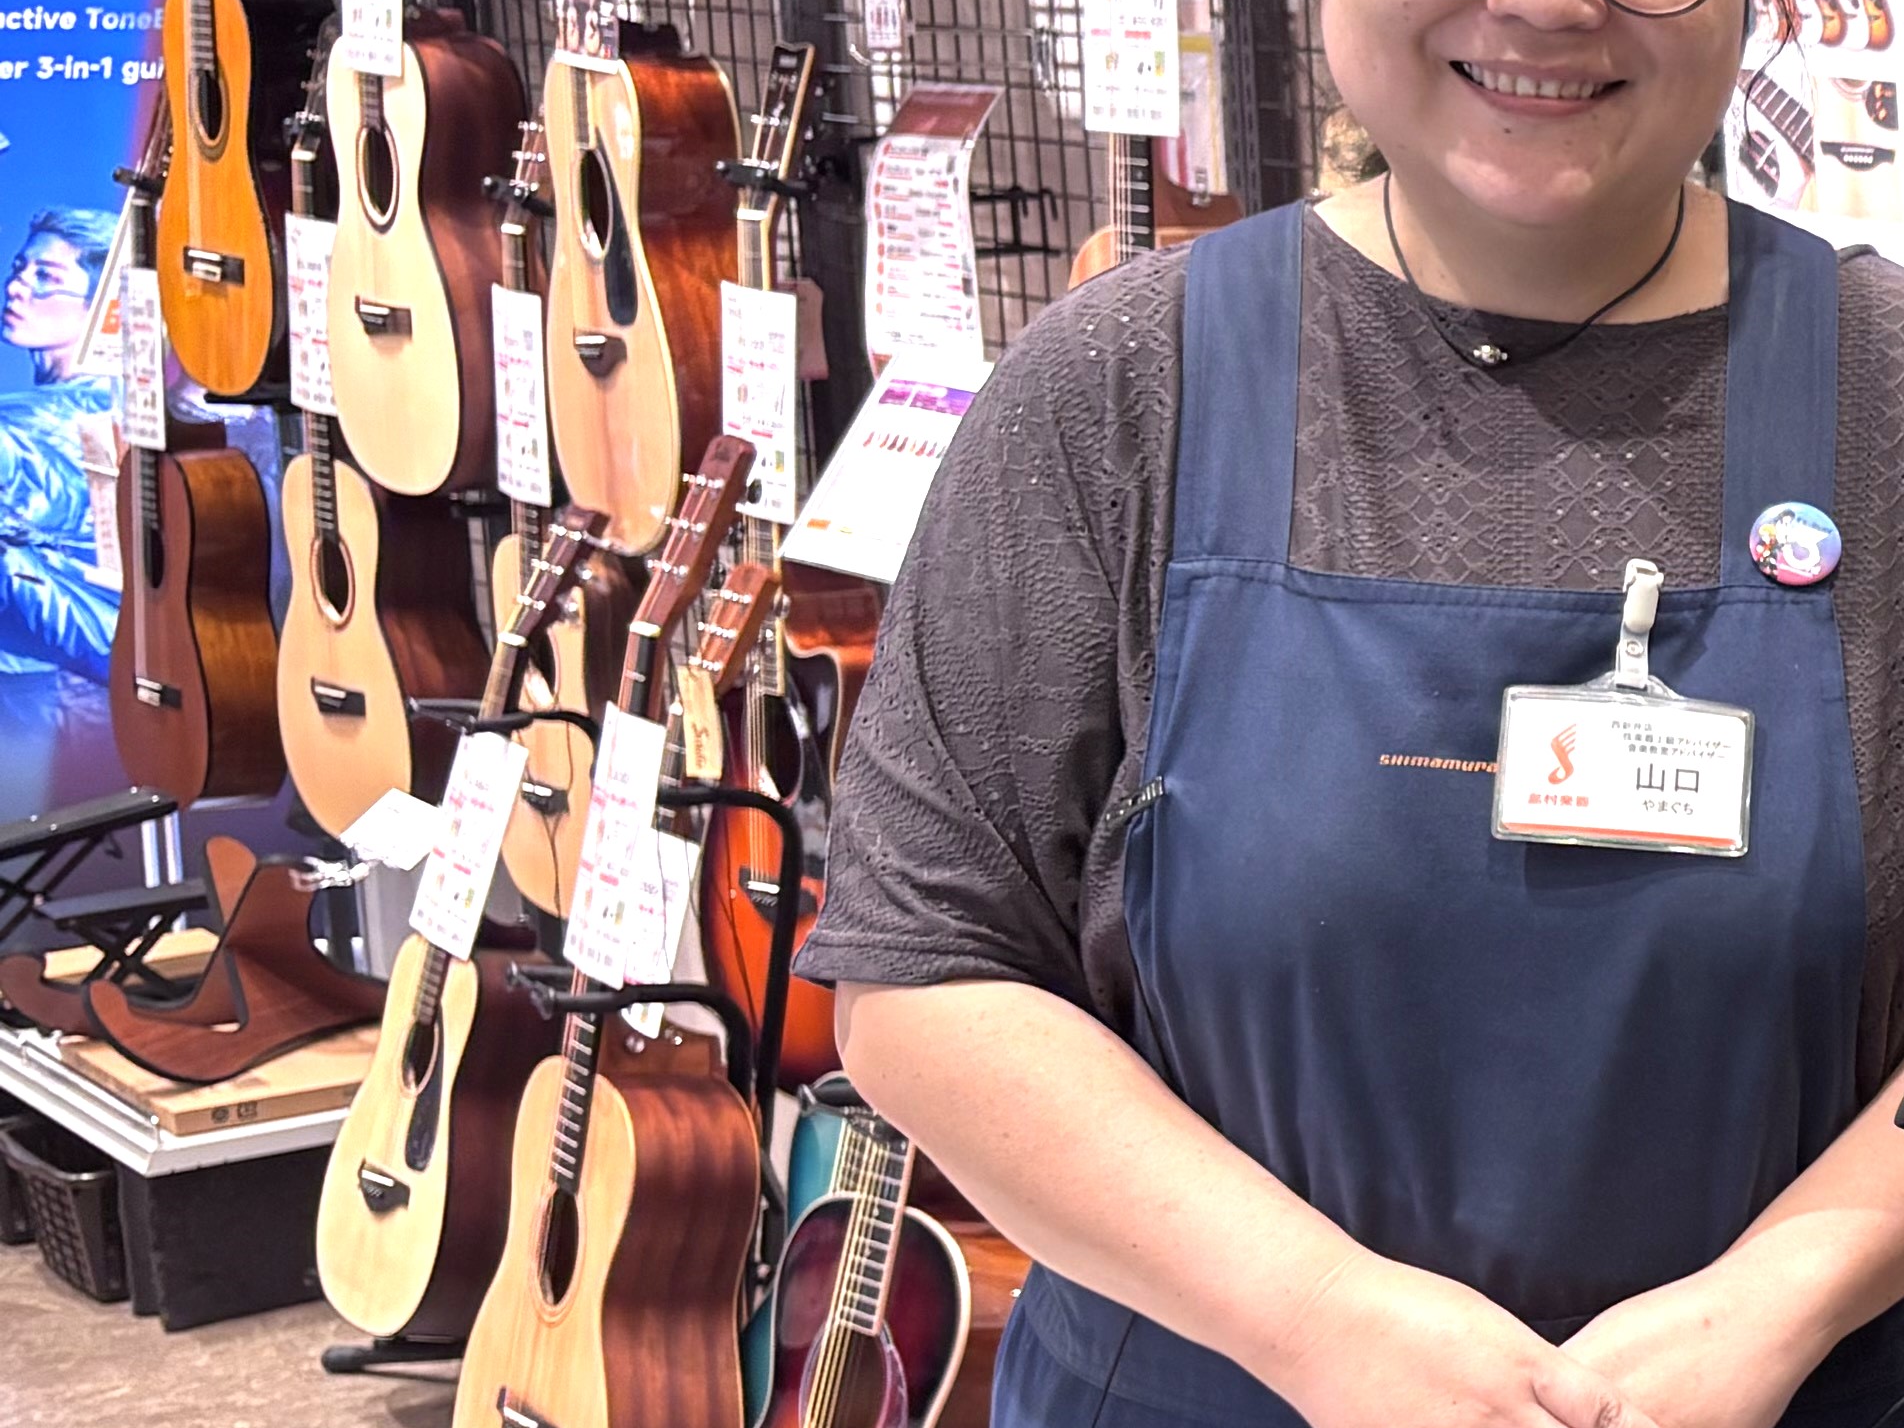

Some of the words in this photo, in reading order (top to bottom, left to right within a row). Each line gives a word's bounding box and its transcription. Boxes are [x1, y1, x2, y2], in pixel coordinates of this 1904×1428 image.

[36, 54, 113, 80] 3-in-1
[1636, 762, 1700, 794] 山口
[1642, 799, 1694, 816] やまぐち
